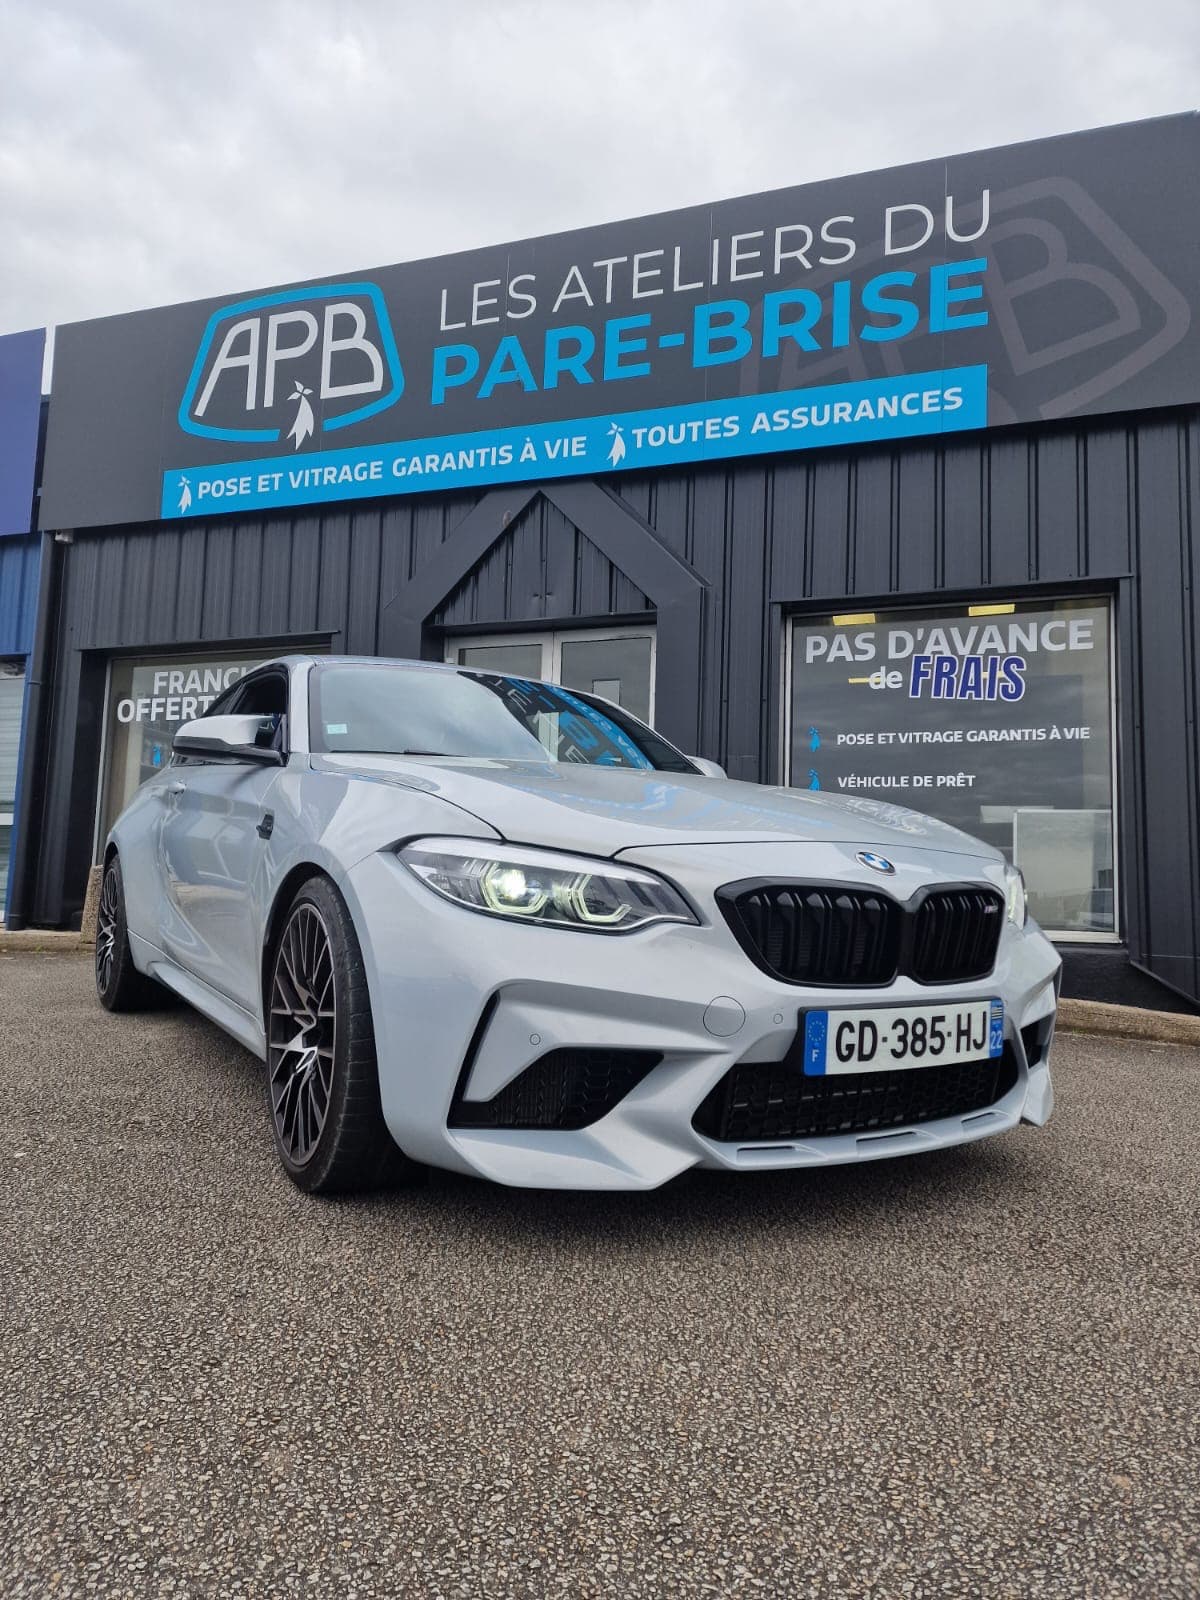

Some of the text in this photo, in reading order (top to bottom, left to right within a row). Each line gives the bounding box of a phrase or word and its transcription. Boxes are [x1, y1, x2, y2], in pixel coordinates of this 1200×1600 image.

[440, 189, 990, 331] LES ATELIERS DU
[431, 257, 989, 405] PARE-BRISE
[194, 302, 384, 417] APB
[632, 387, 964, 449] TOUTES ASSURANCES
[197, 435, 587, 500] POSE ET VITRAGE GARANTIS À VIE
[805, 619, 1094, 664] PAS D'AVANCE
[153, 667, 248, 695] FRANC
[869, 654, 1027, 702] de FRAIS
[117, 694, 220, 723] OFFERT
[837, 725, 1090, 745] POSE ET VITRAGE GARANTIS À VIE
[837, 772, 976, 788] VÉHICULE DE PRÊT
[811, 1049, 820, 1062] F
[990, 1030, 1003, 1050] 22
